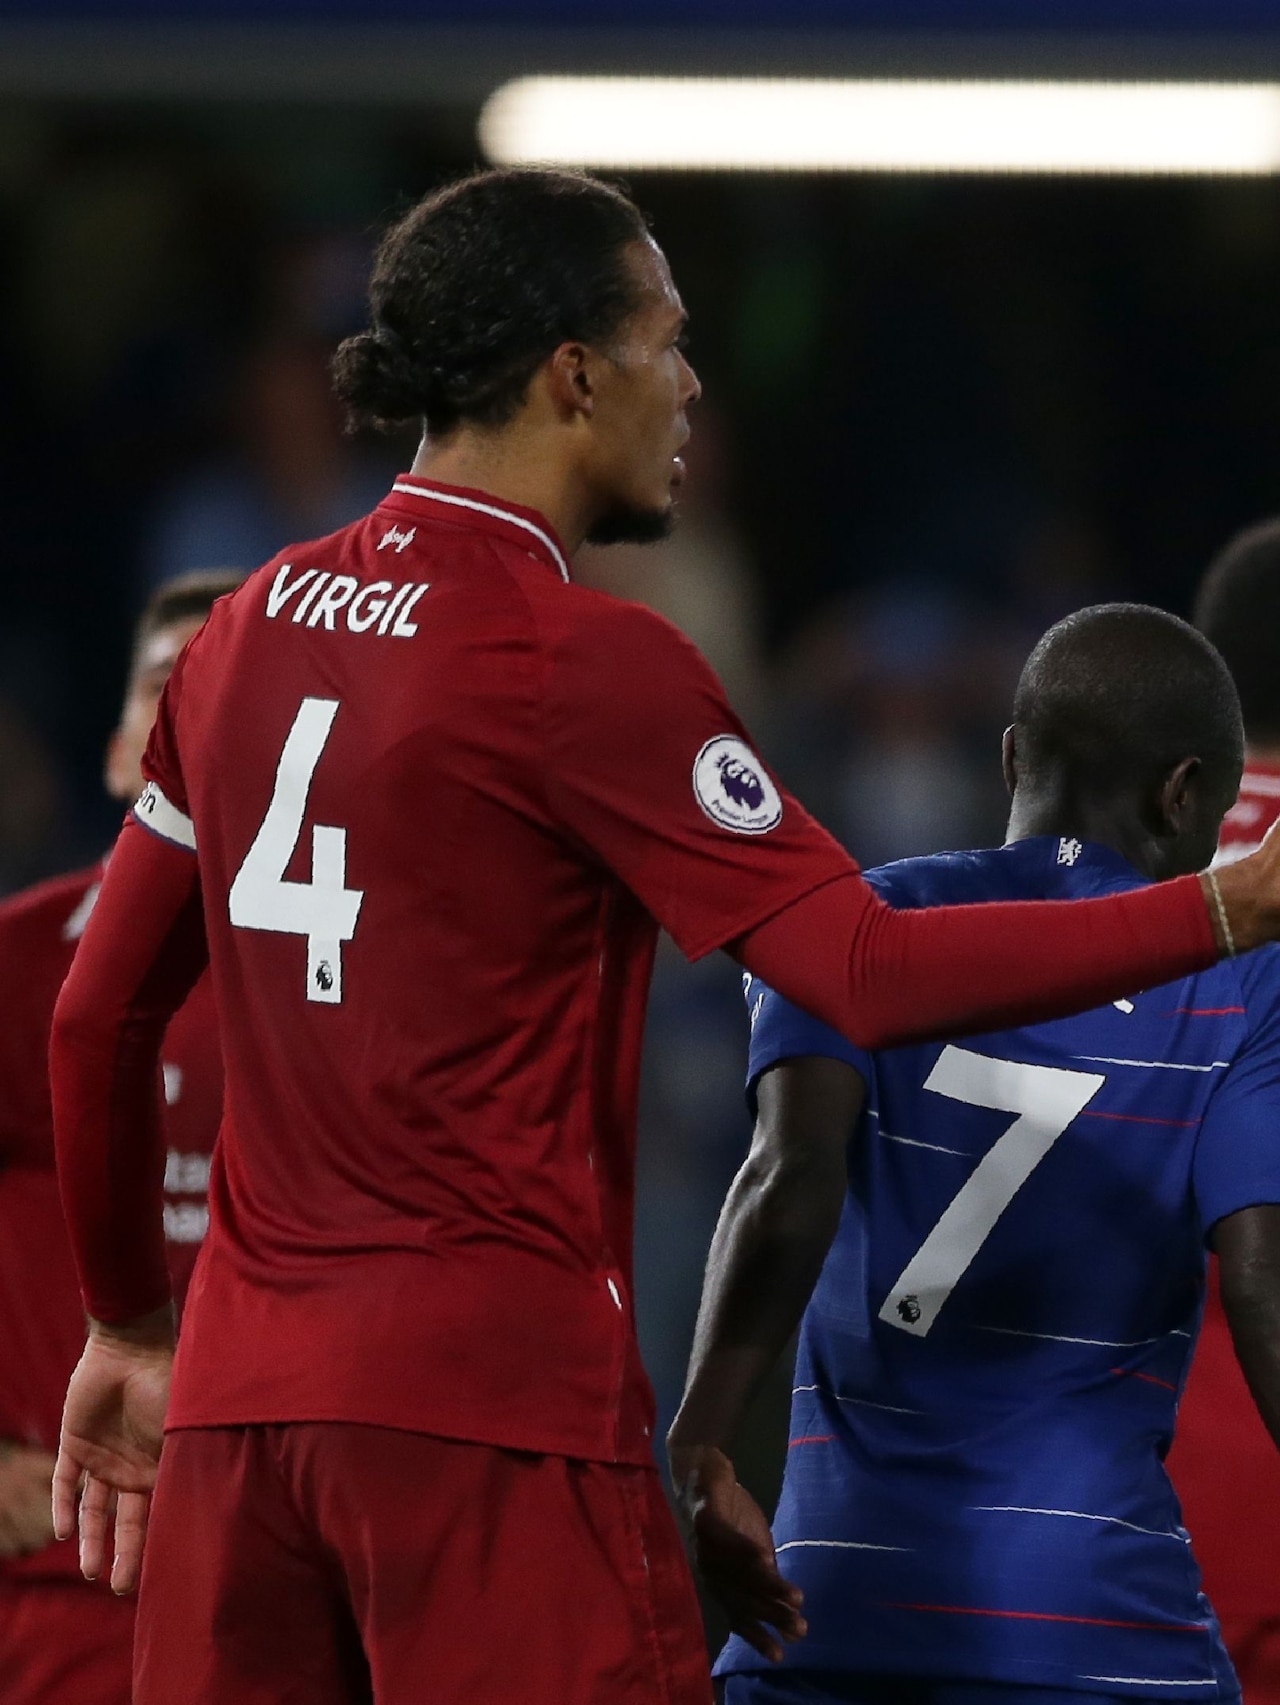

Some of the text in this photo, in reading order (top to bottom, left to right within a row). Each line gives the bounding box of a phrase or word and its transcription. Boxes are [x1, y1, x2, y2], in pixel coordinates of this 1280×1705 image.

[266, 564, 430, 637] VIRGIL
[228, 695, 365, 1004] 4
[877, 1043, 1106, 1338] 7
